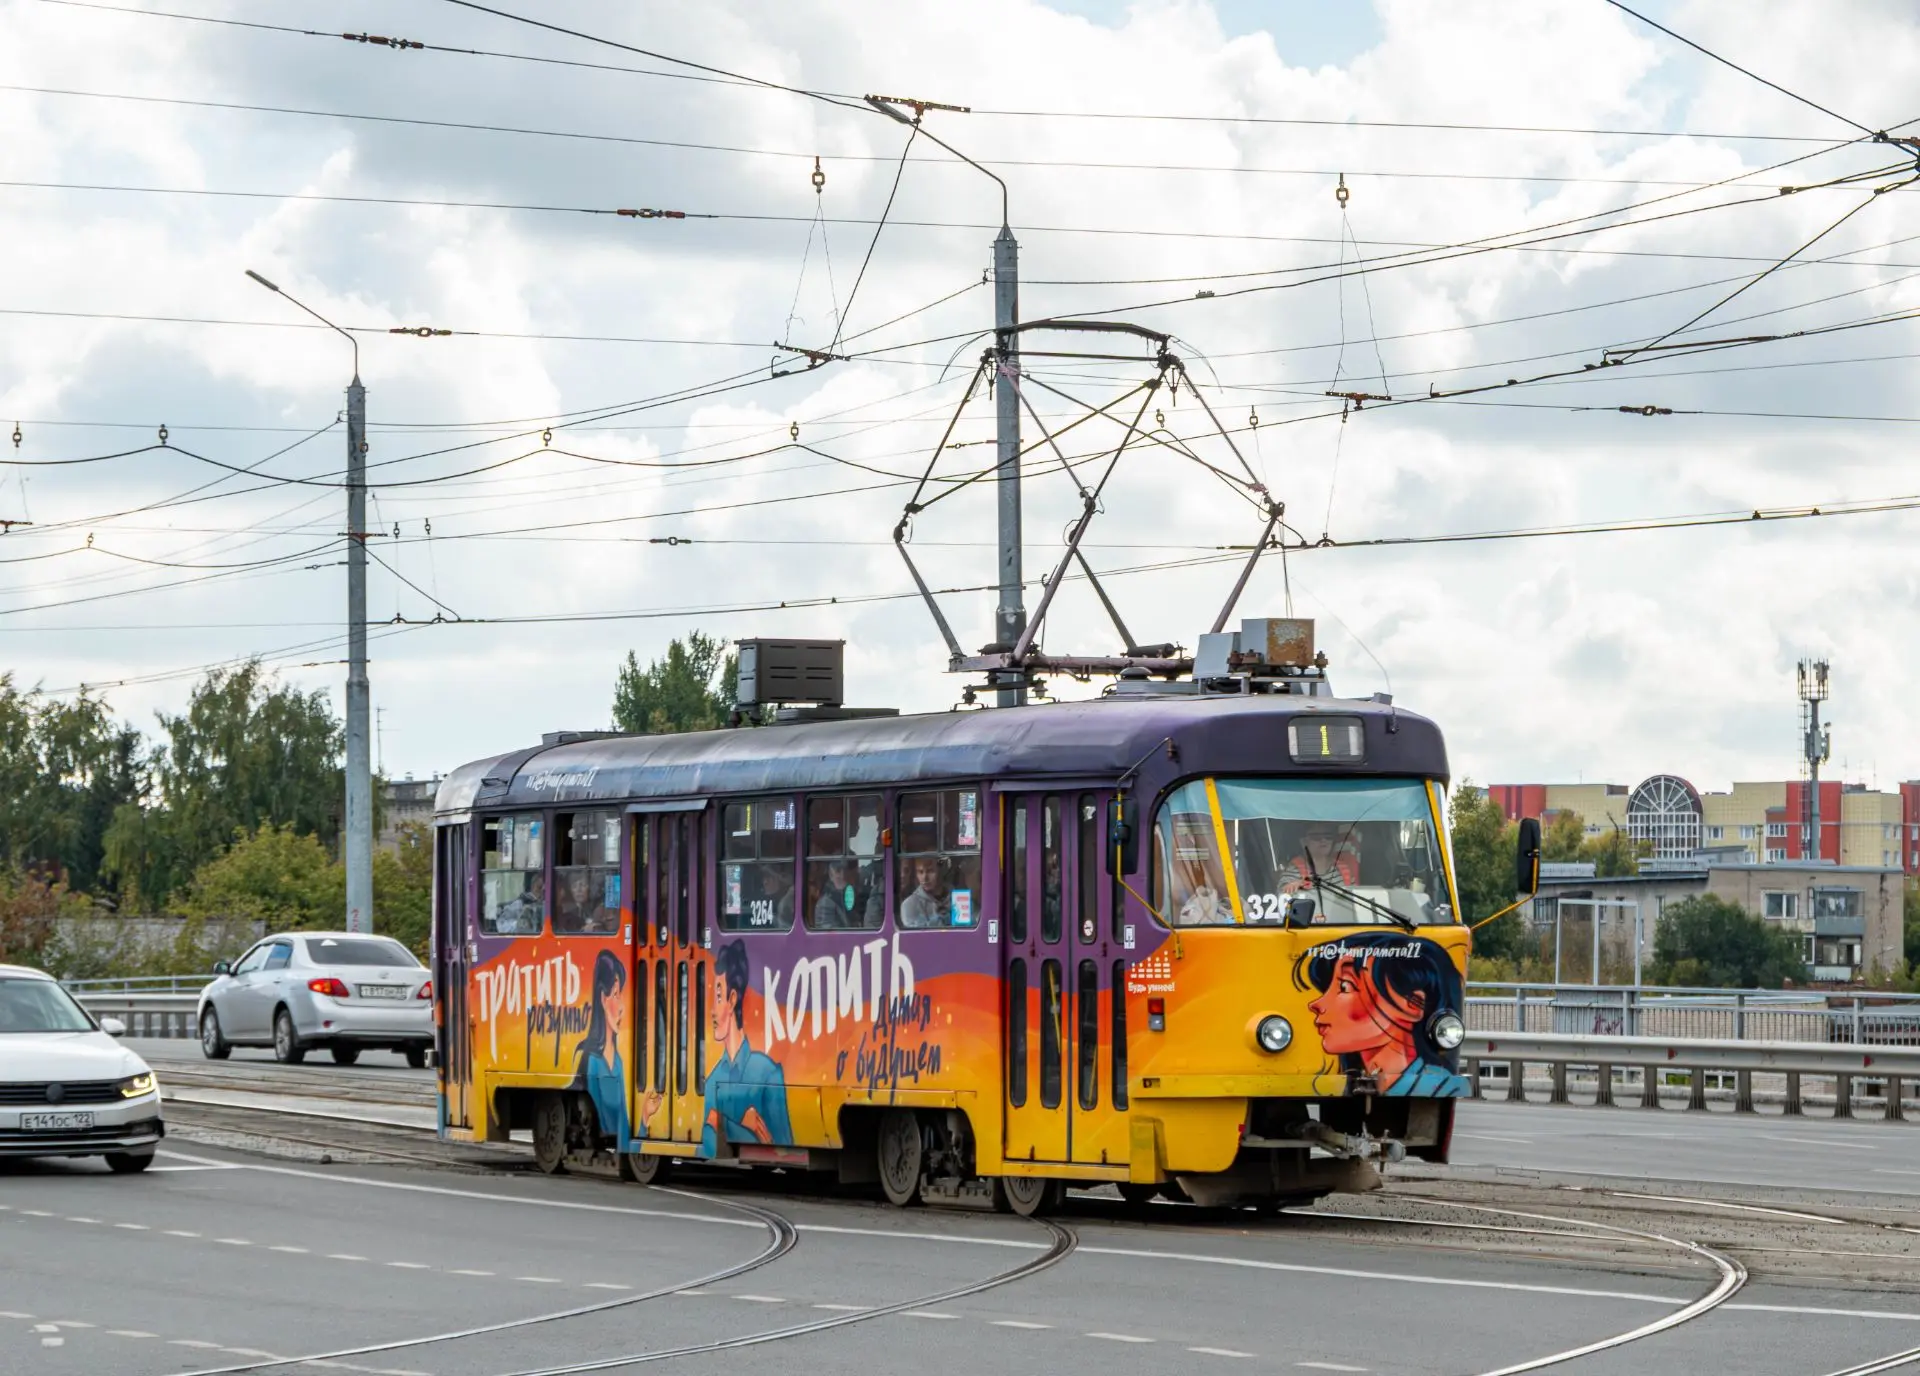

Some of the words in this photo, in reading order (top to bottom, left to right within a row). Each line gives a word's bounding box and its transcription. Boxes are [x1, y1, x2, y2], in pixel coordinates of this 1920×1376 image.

[1319, 725, 1330, 755] 1
[750, 899, 773, 925] 3264
[526, 999, 592, 1072] разумно
[856, 1032, 942, 1106] будущем
